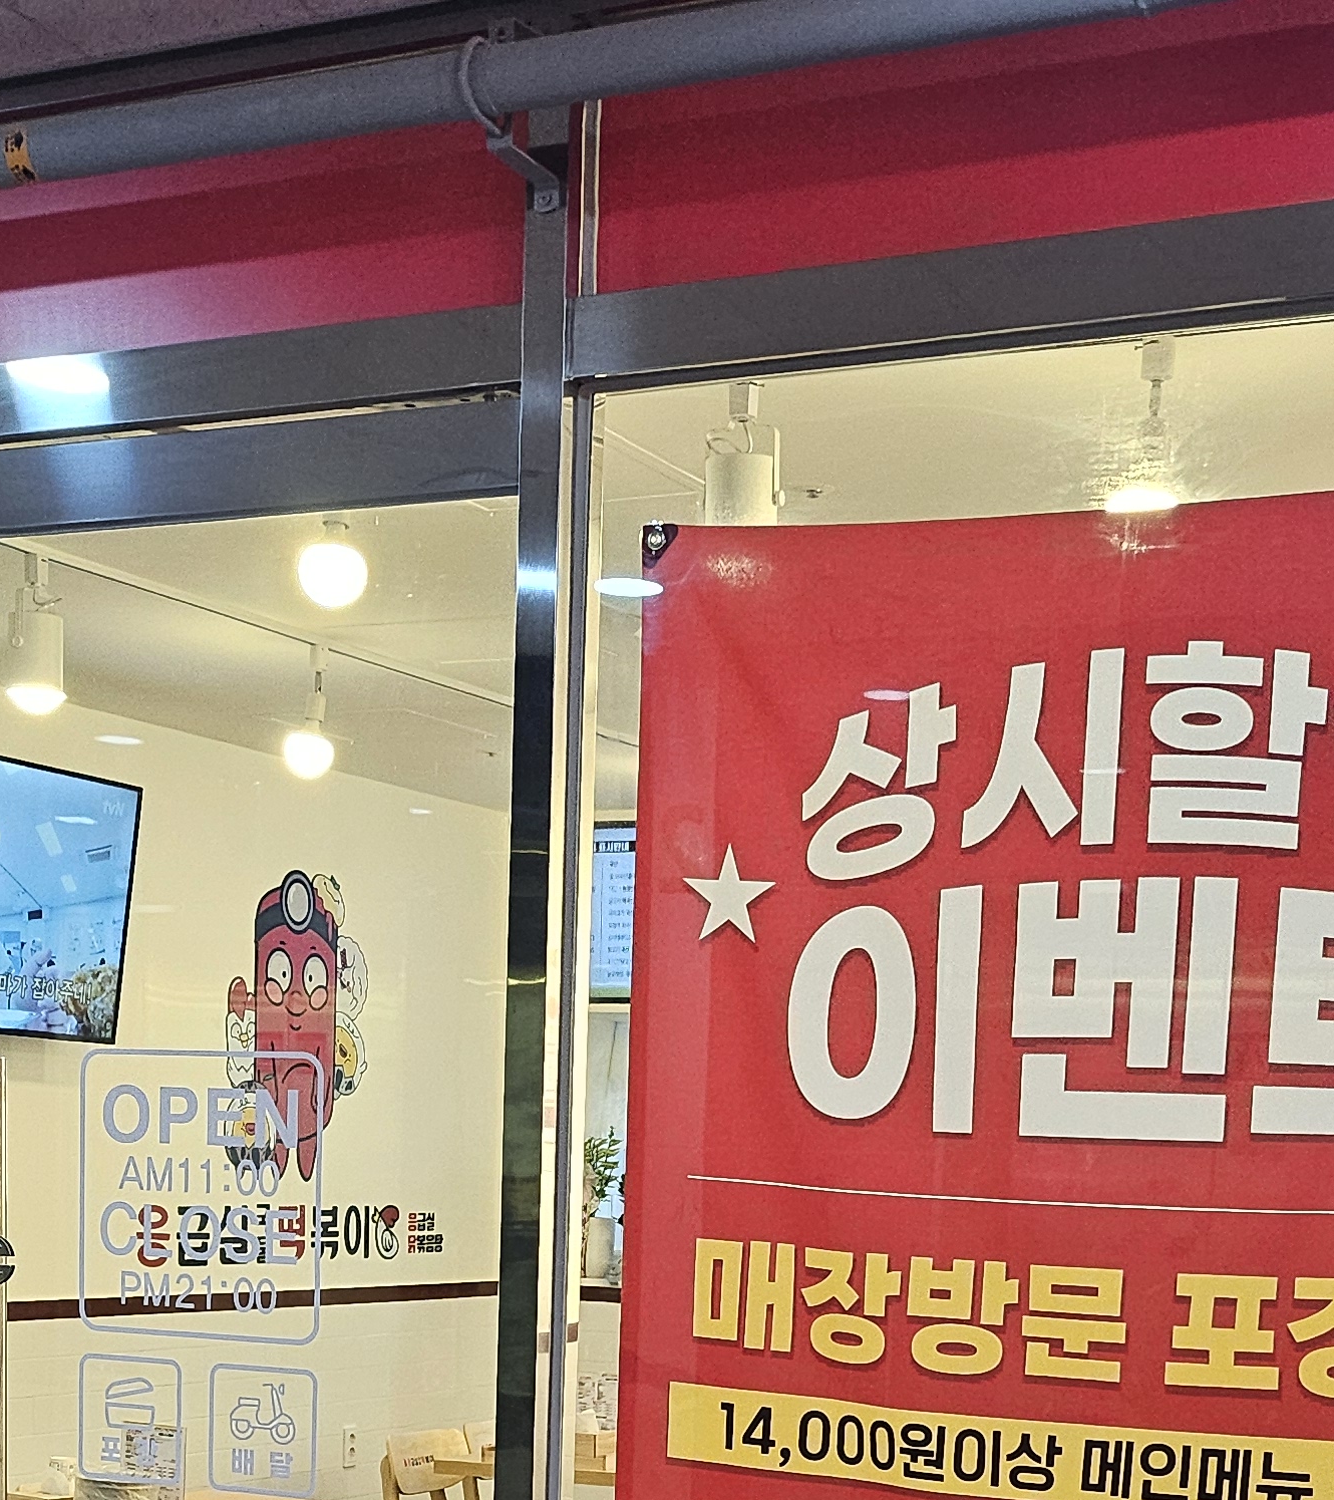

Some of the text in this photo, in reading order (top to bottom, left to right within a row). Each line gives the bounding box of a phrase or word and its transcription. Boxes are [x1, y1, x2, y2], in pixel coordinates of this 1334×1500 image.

[31, 976, 93, 1005] 잡아주네!
[102, 1084, 301, 1150] OPEN
[99, 1200, 300, 1265] CLOSE
[407, 1212, 435, 1232] 응급실
[692, 1237, 1127, 1384] 매장방문
[720, 1402, 1064, 1492] 14,000원이상
